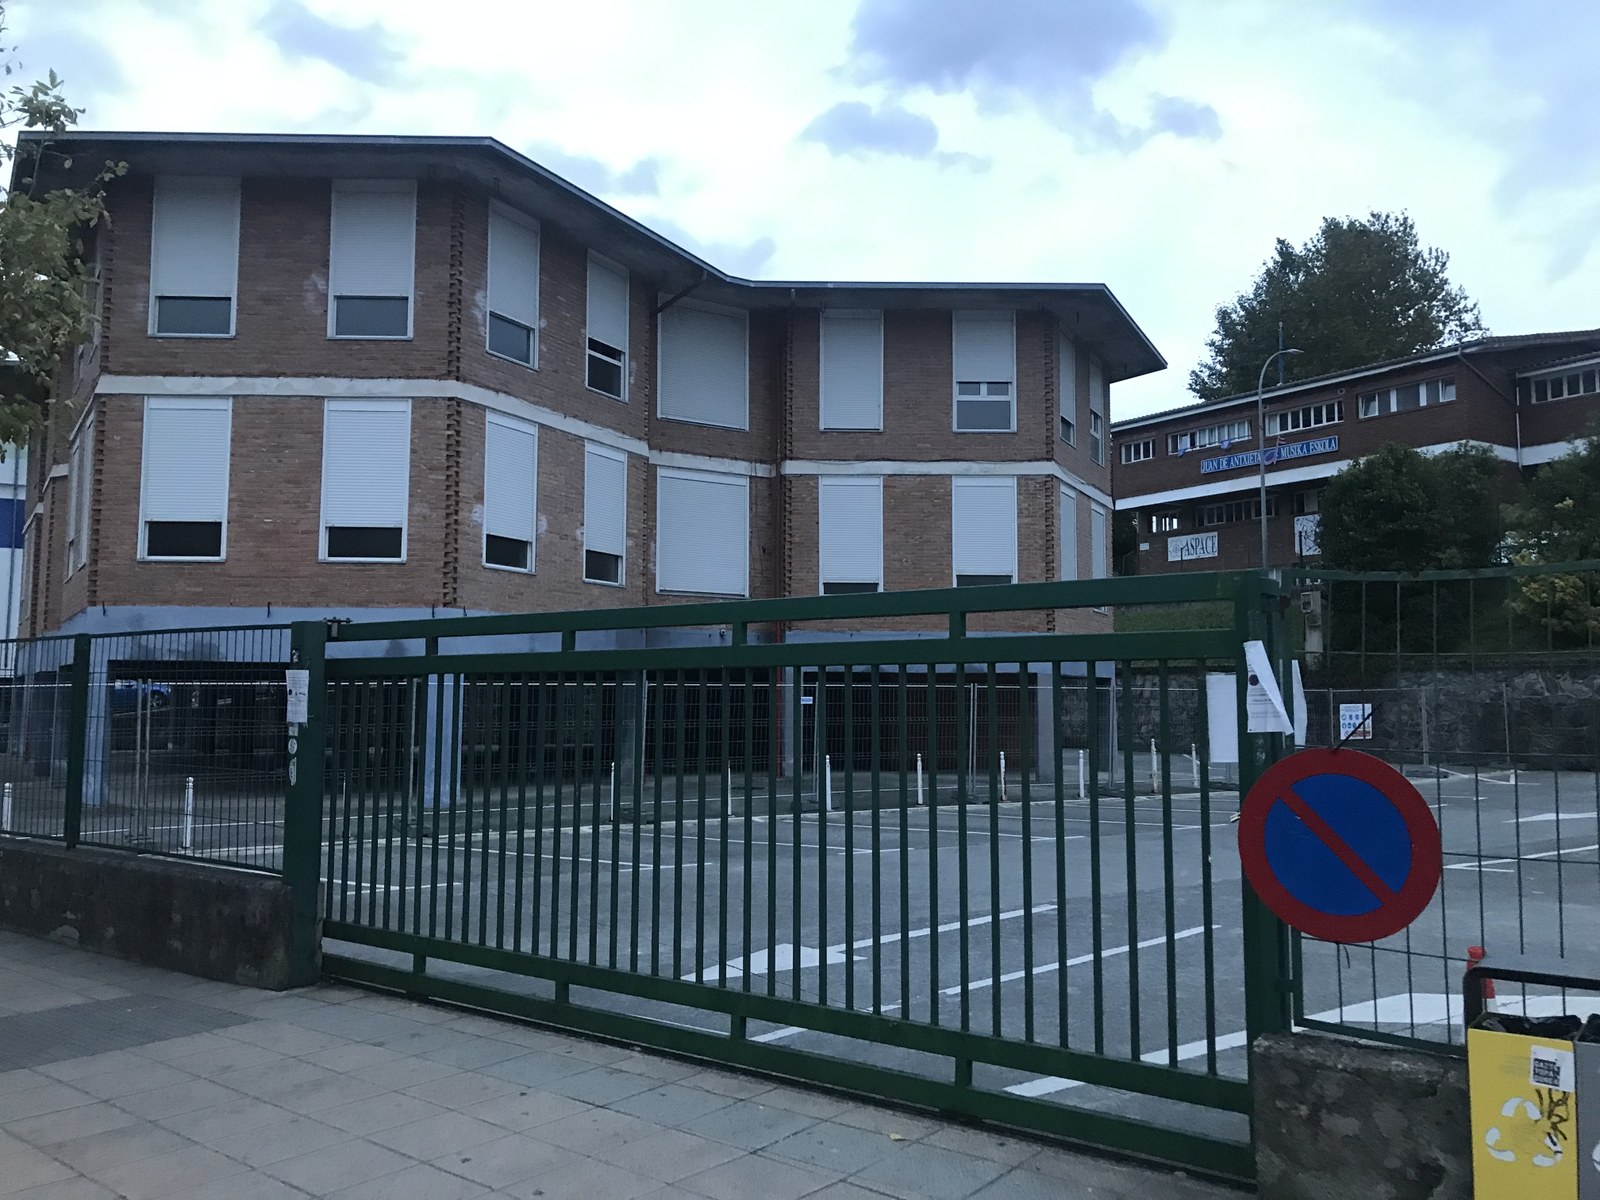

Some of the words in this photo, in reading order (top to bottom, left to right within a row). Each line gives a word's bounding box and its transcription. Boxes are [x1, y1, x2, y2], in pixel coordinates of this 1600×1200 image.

[1202, 459, 1218, 473] JUAN
[1219, 457, 1229, 470] DE
[1280, 442, 1308, 459] MUSIKA
[1309, 438, 1337, 454] ESKOLA
[1184, 535, 1217, 557] ASPACE
